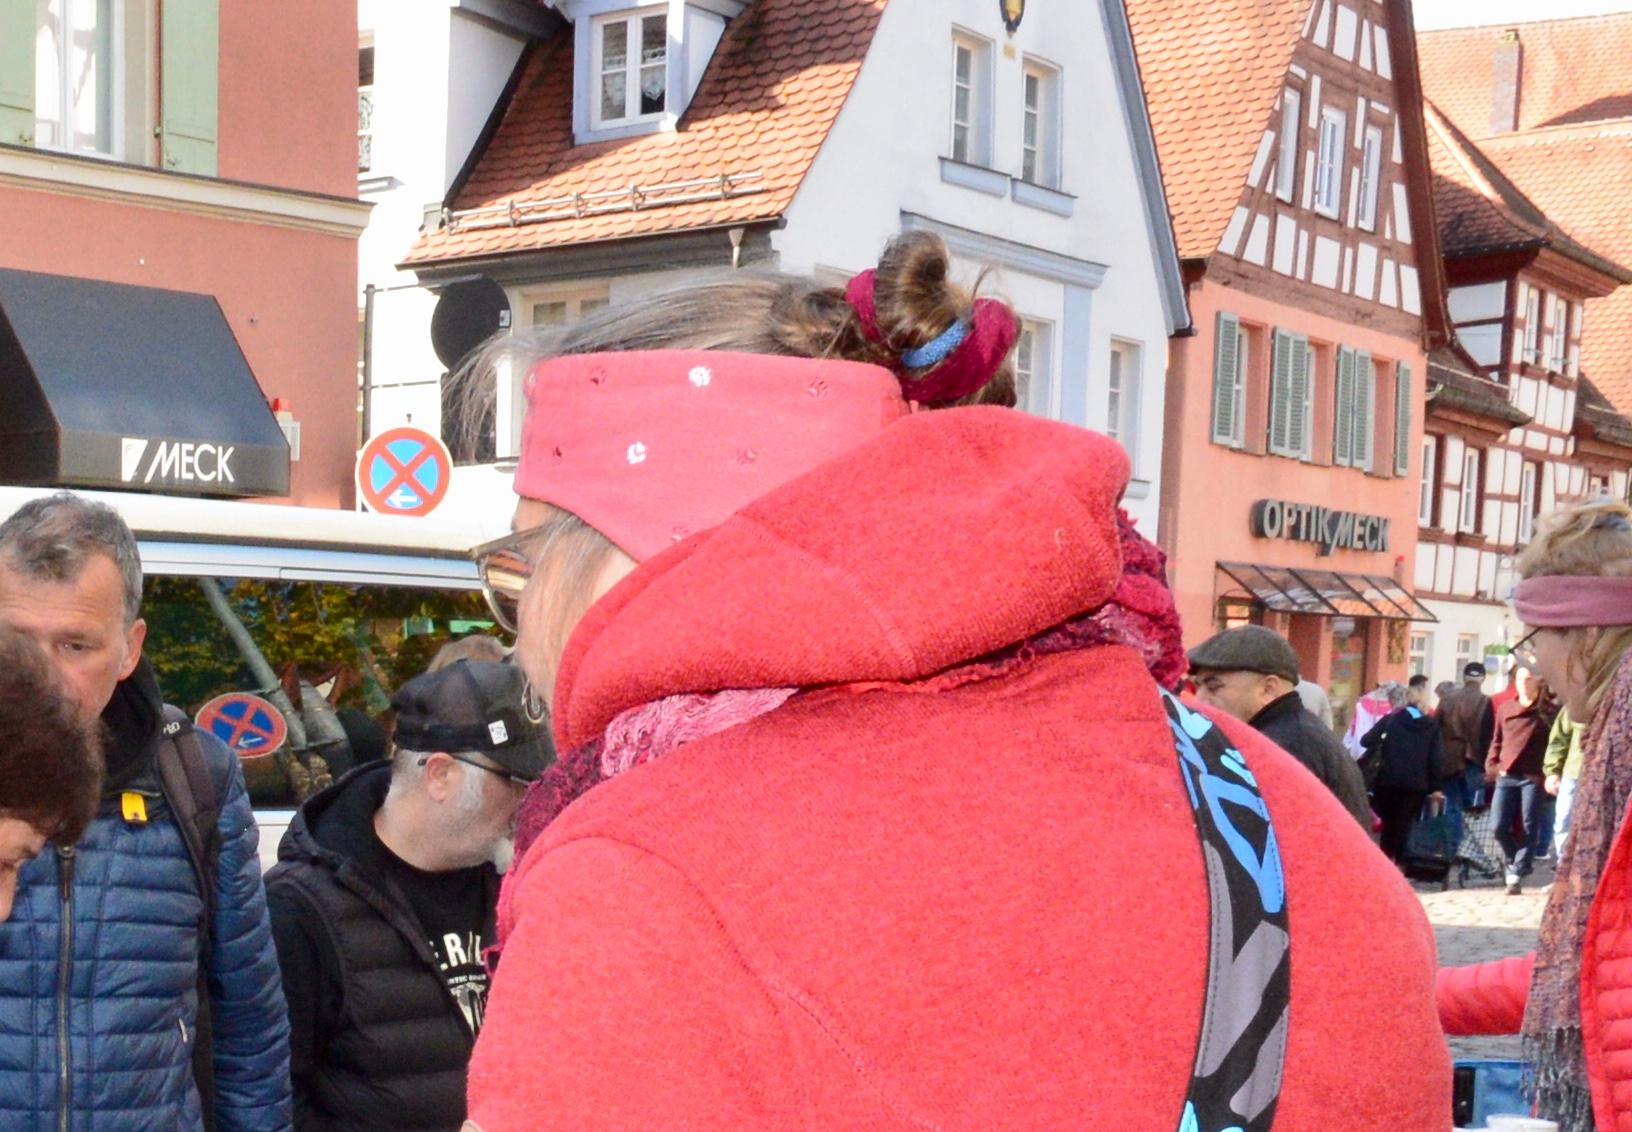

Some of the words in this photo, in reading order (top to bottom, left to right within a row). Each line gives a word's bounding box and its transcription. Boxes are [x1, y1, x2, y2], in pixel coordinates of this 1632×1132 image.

[144, 440, 235, 483] MECK
[1262, 500, 1332, 544] OPTIK
[1329, 510, 1392, 556] MECK
